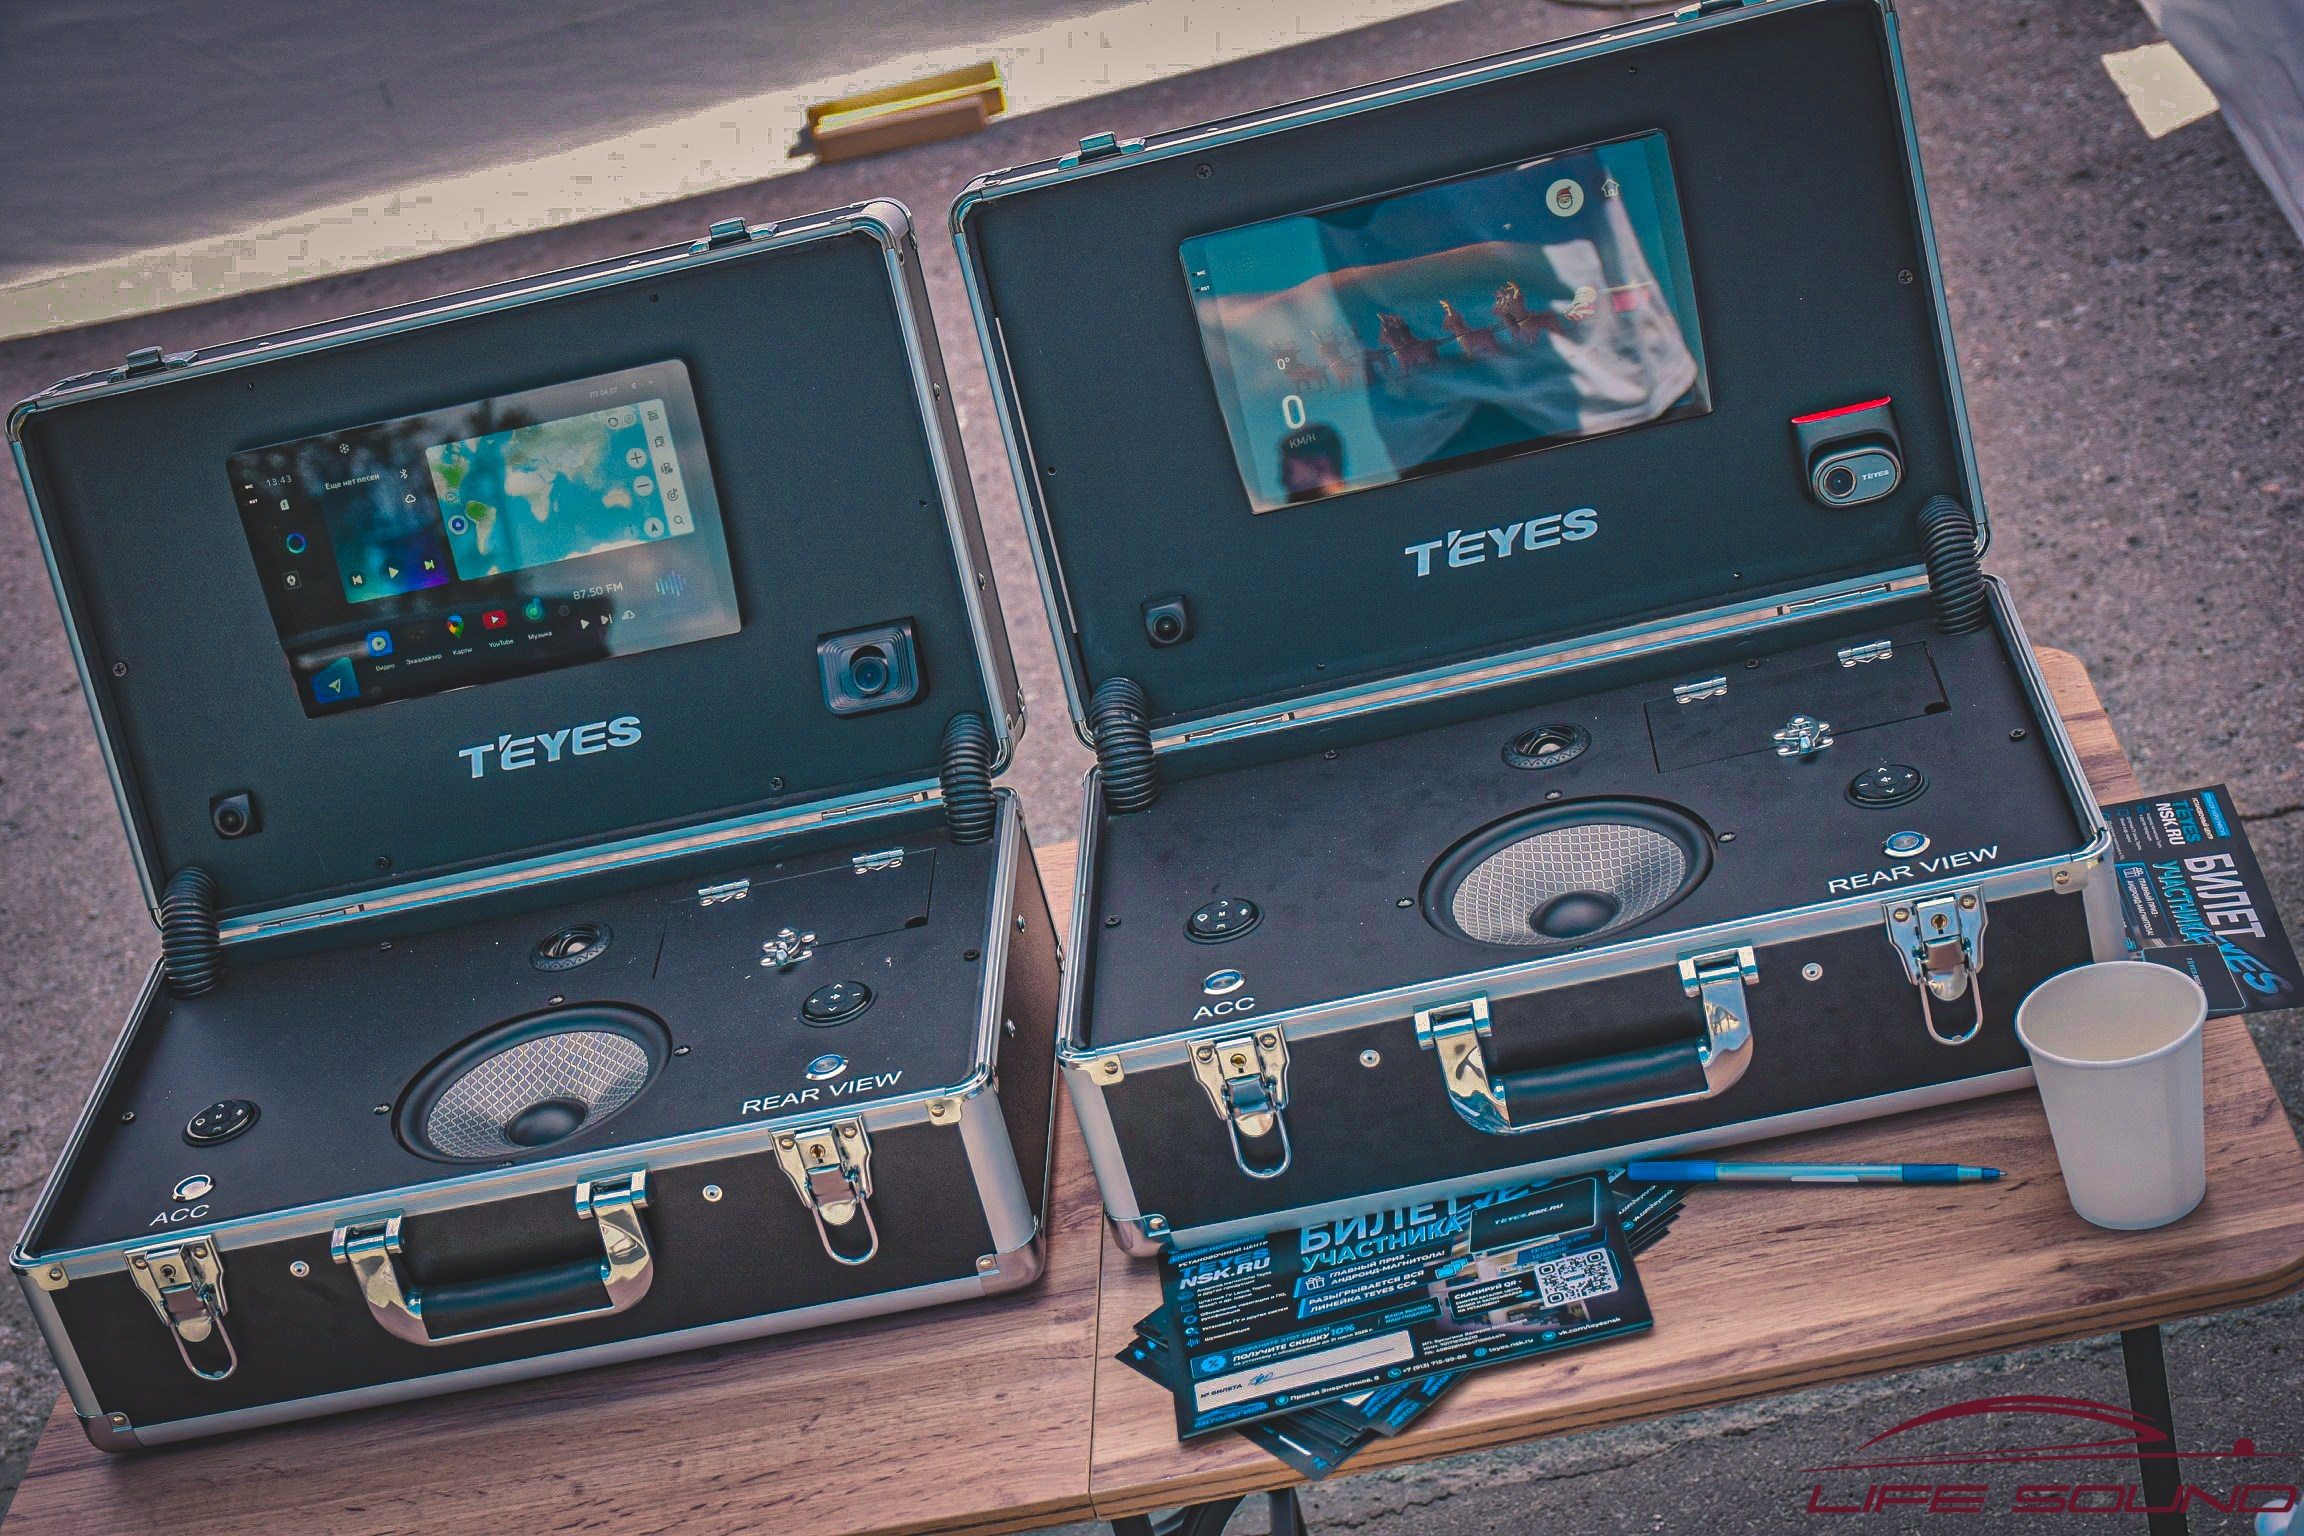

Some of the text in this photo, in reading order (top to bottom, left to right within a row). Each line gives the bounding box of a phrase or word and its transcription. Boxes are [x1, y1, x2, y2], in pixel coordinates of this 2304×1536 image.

[1282, 395, 1306, 429] 0
[1289, 433, 1316, 449] KM/H
[325, 472, 380, 490] Еще нет песен
[573, 582, 624, 600] 87.50 FM
[488, 638, 514, 649] YouTube
[527, 630, 553, 641] Музыка
[452, 647, 473, 656] Карты
[375, 662, 396, 672] Видео
[2156, 802, 2186, 846] NSK.RU
[1828, 845, 1998, 894] REAR VIEW
[2138, 878, 2154, 902] ГЛАВНЫЙ
[2152, 860, 2209, 942] УЧАСТНИКА
[2184, 853, 2266, 938] БИЛЕТ
[1193, 997, 1255, 1021] ACC
[742, 1070, 903, 1115] REAR VIEW
[149, 1204, 210, 1227] ACC
[1495, 1203, 1564, 1225] TEYES.NSK.RU
[1178, 1240, 1268, 1268] УСТАНОВОЧНЫЙ ЦЕНТР
[1302, 1215, 1463, 1273] УЧАСТНИКА
[1180, 1247, 1269, 1278] TEYES
[1180, 1257, 1271, 1289] NSK.RU
[1329, 1261, 1377, 1278] ГЛАВНЫЙ
[1379, 1253, 1405, 1266] ПРИЗ
[1331, 1250, 1445, 1286] АНДРОИД-МАГНИТОЛА!
[1309, 1269, 1424, 1306] РАЗЫГРЫВАЕТСЯ ВСЯ
[1310, 1293, 1362, 1313] ЛИНЕЙКА
[1363, 1285, 1395, 1299] TEYES
[1454, 1282, 1503, 1300] СКАНИРУЙ
[1504, 1279, 1518, 1288] QR
[1558, 1317, 1621, 1336] vk.com/teyesnsk
[1232, 1326, 1331, 1355] СОХРАНИТЕ ЭТОТ БИЛЕТ!
[1232, 1324, 1356, 1362] ПОЛУЧИТЕ СКИДКУ 10%
[1488, 1338, 1534, 1353] teyes.nsk.ru
[1413, 1361, 1430, 1372] (913)
[1211, 1383, 1242, 1396] БИЛЕТА
[1290, 1390, 1319, 1401] Проезд
